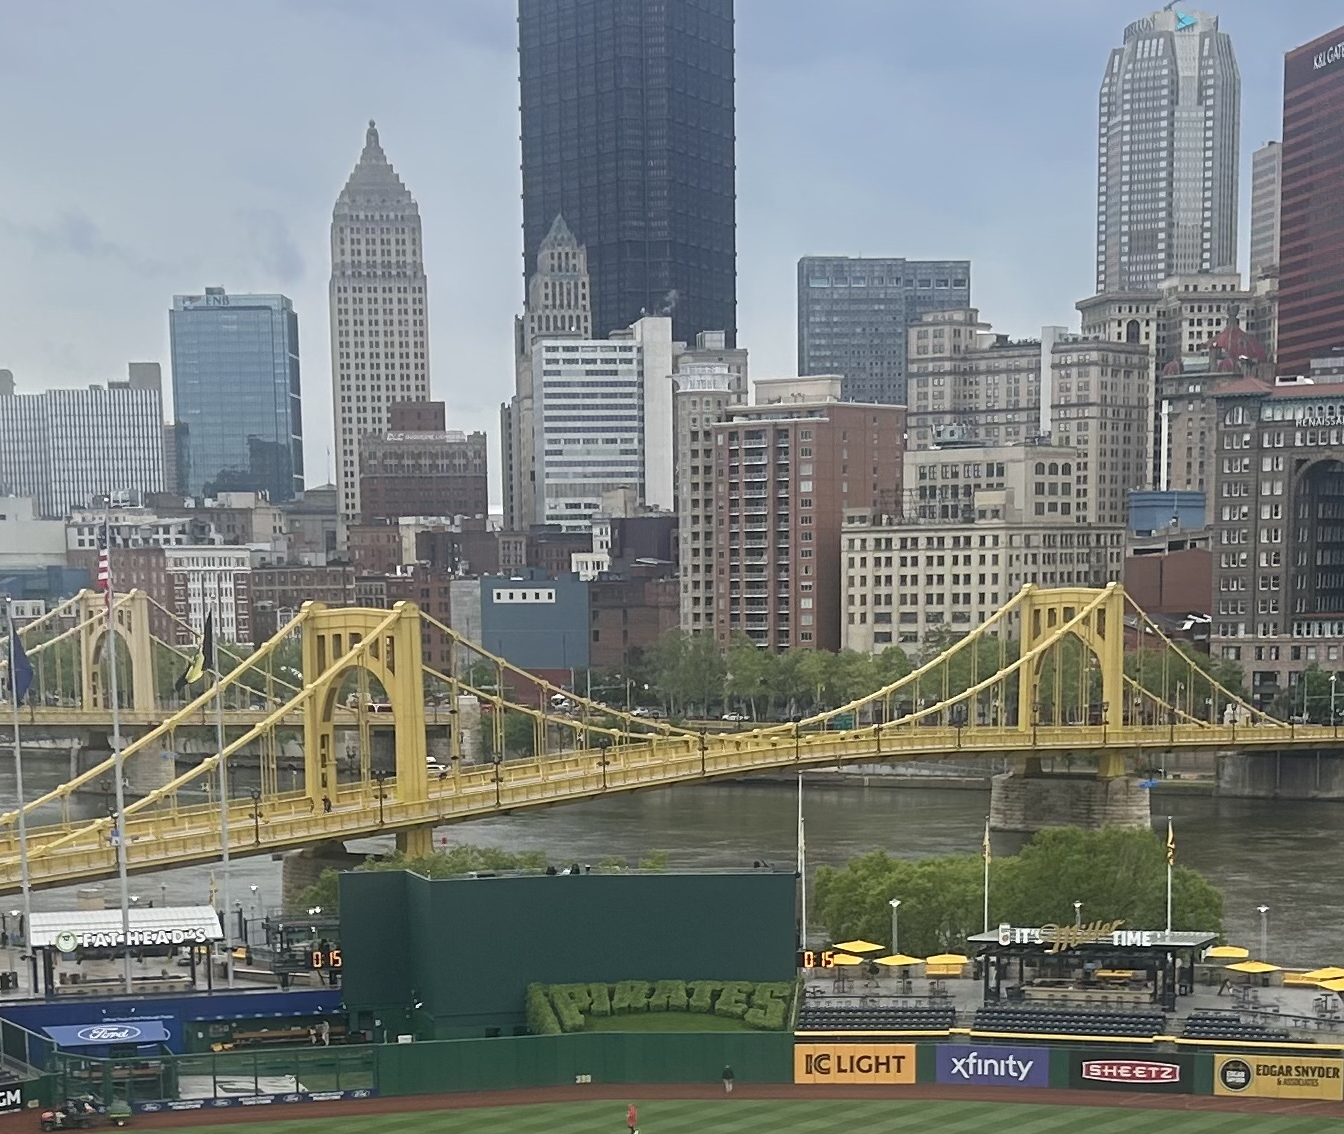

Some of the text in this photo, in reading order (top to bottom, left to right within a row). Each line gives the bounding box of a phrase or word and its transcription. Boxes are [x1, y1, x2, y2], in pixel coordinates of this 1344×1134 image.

[1313, 53, 1327, 70] K&L
[82, 928, 208, 948] FAT HEAD'S
[1015, 919, 1151, 955] IT'S Miller TIME
[313, 950, 342, 968] 0:15
[804, 951, 834, 968] 0:15
[547, 979, 793, 1033] PIRATES
[89, 1027, 129, 1039] Ford
[805, 1053, 905, 1075] IC LIGHT
[951, 1052, 1034, 1081] xfinity
[1089, 1064, 1174, 1079] SHEETZ
[1256, 1064, 1340, 1078] EDGAR SNYDER
